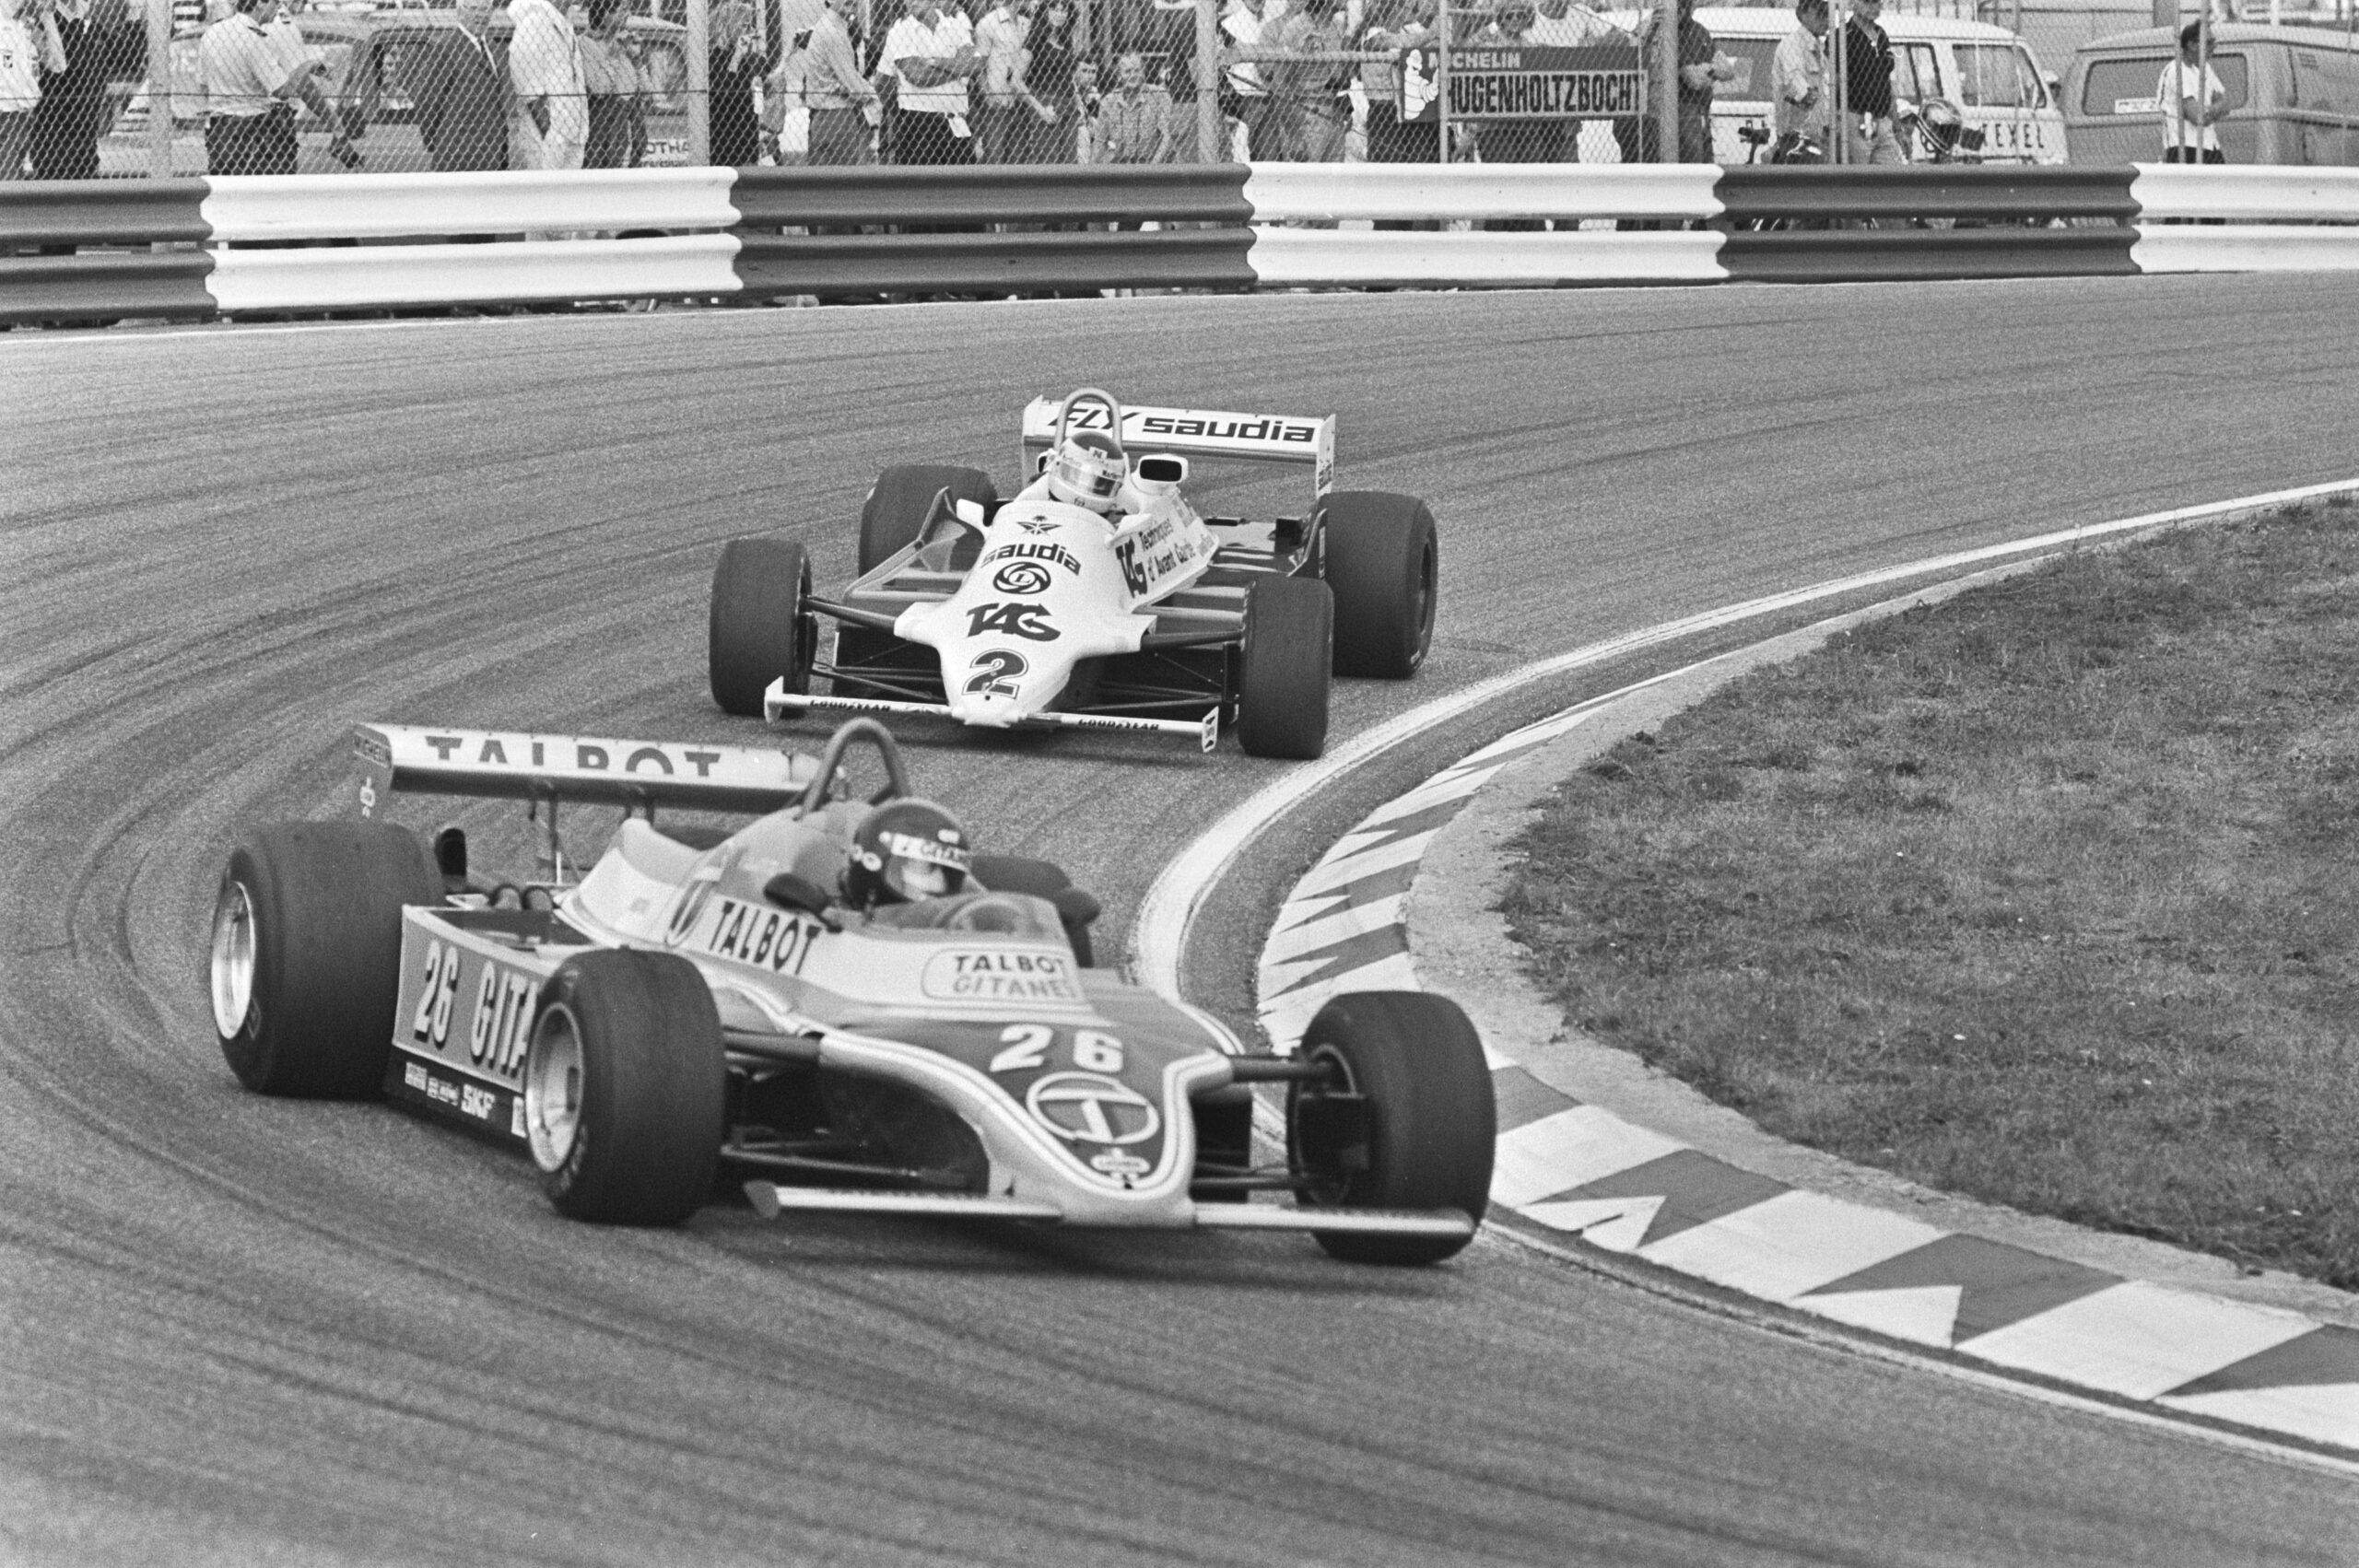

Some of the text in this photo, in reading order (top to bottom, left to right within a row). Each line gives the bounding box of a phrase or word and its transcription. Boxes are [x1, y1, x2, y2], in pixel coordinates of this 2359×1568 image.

[1428, 52, 1520, 68] MCHELIN
[1143, 417, 1316, 443] saudia
[980, 544, 1082, 576] saudia
[966, 603, 1062, 642] TAG
[961, 648, 1029, 700] 2
[710, 901, 821, 975] TALBOT
[415, 940, 459, 1050] 26
[990, 1024, 1123, 1073] 26
